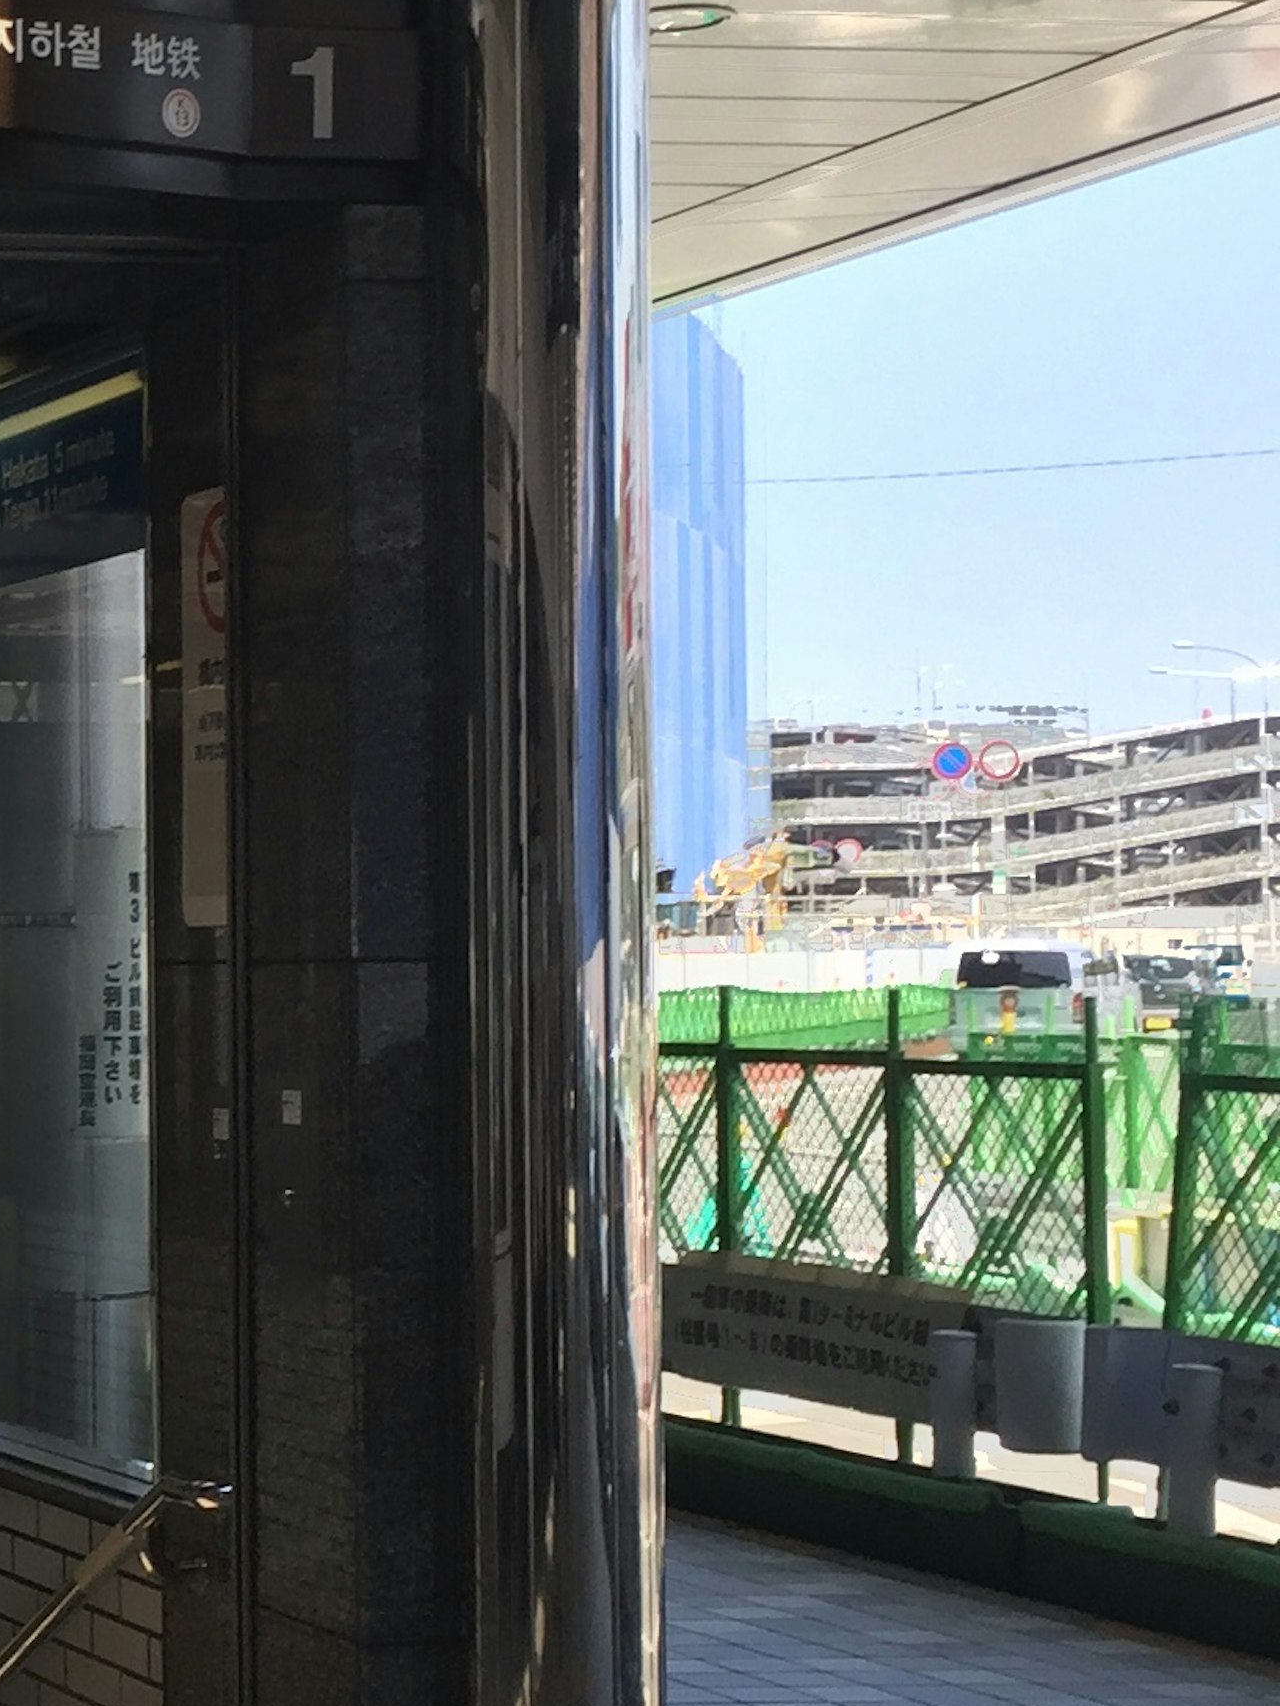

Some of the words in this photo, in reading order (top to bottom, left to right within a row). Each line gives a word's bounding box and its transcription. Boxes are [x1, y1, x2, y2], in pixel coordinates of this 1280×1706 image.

[130, 30, 202, 81] 地铁
[290, 46, 336, 140] 1
[0, 450, 50, 492] Hakata
[102, 960, 123, 1106] ご利用下さい
